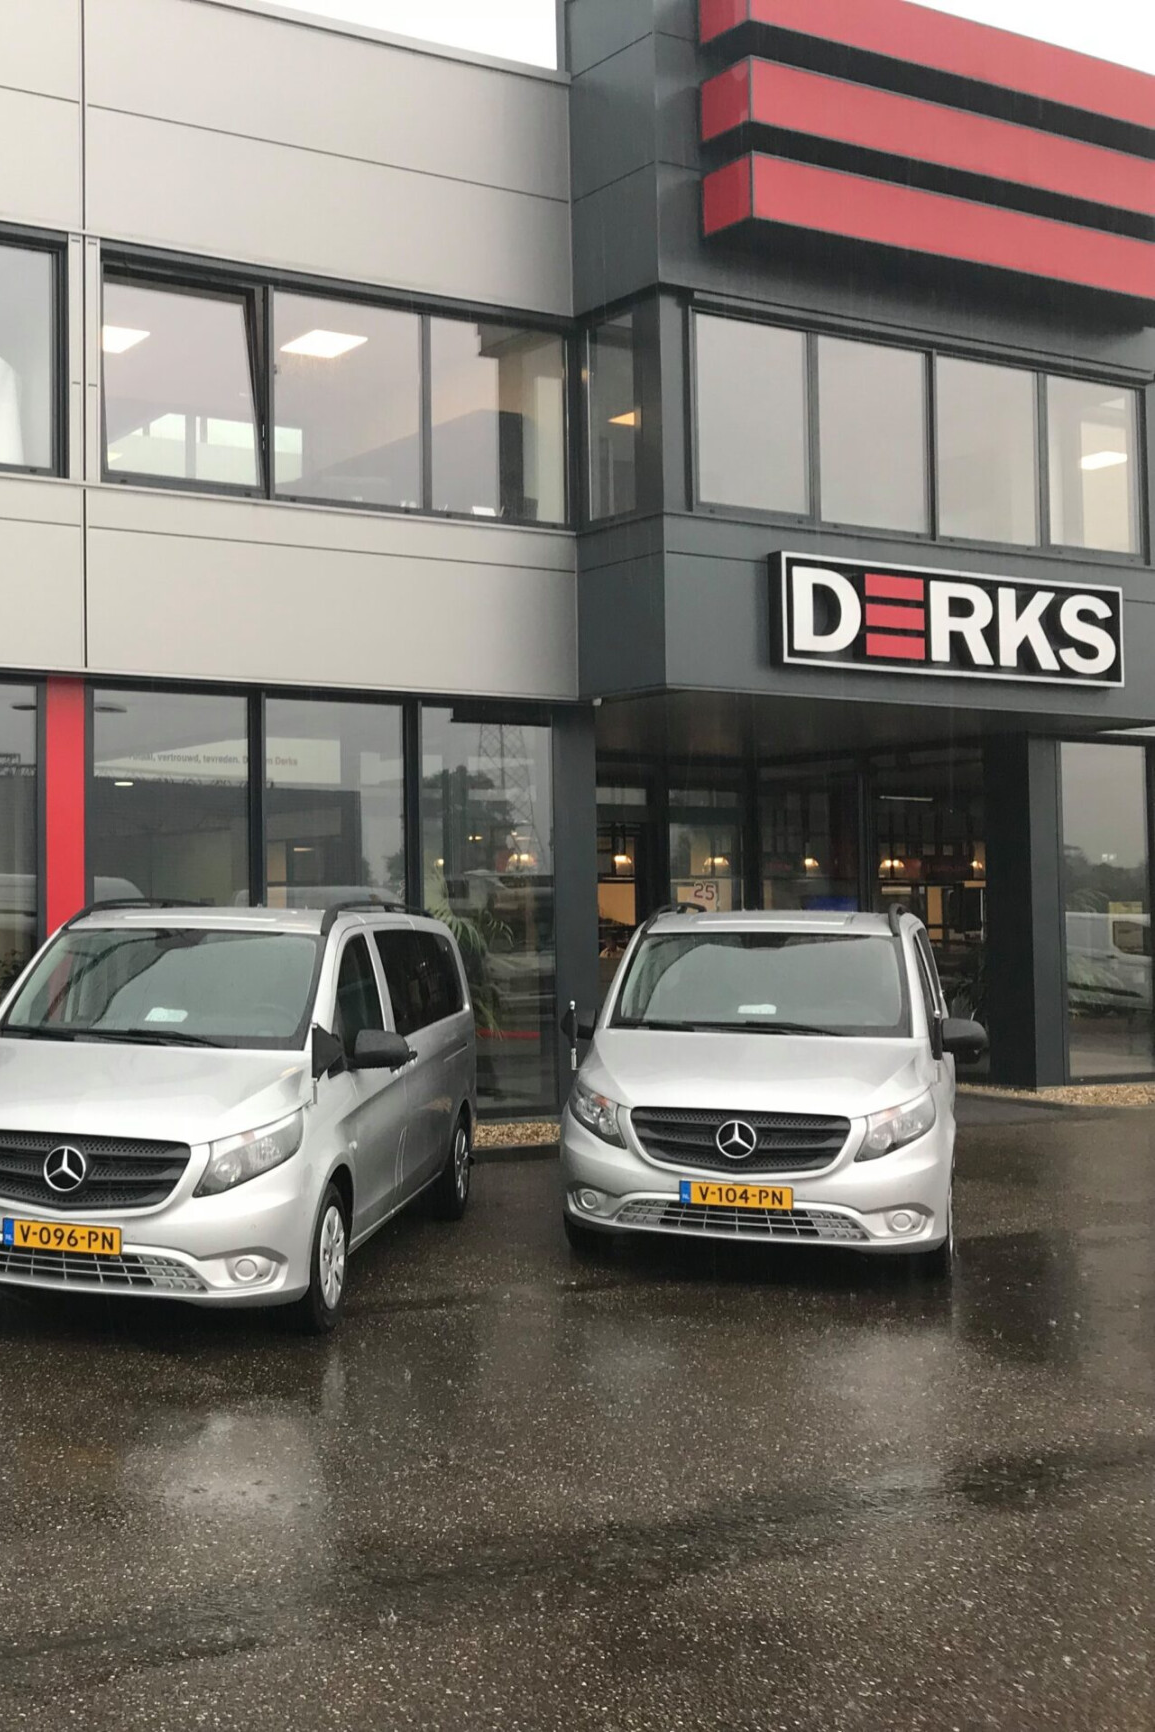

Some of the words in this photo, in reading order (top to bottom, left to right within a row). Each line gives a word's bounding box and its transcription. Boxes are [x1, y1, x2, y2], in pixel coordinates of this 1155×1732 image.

[792, 565, 1116, 675] DERKS
[694, 882, 715, 901] 25
[699, 1185, 784, 1206] V-104-PN
[19, 1224, 114, 1251] V-096-PN
